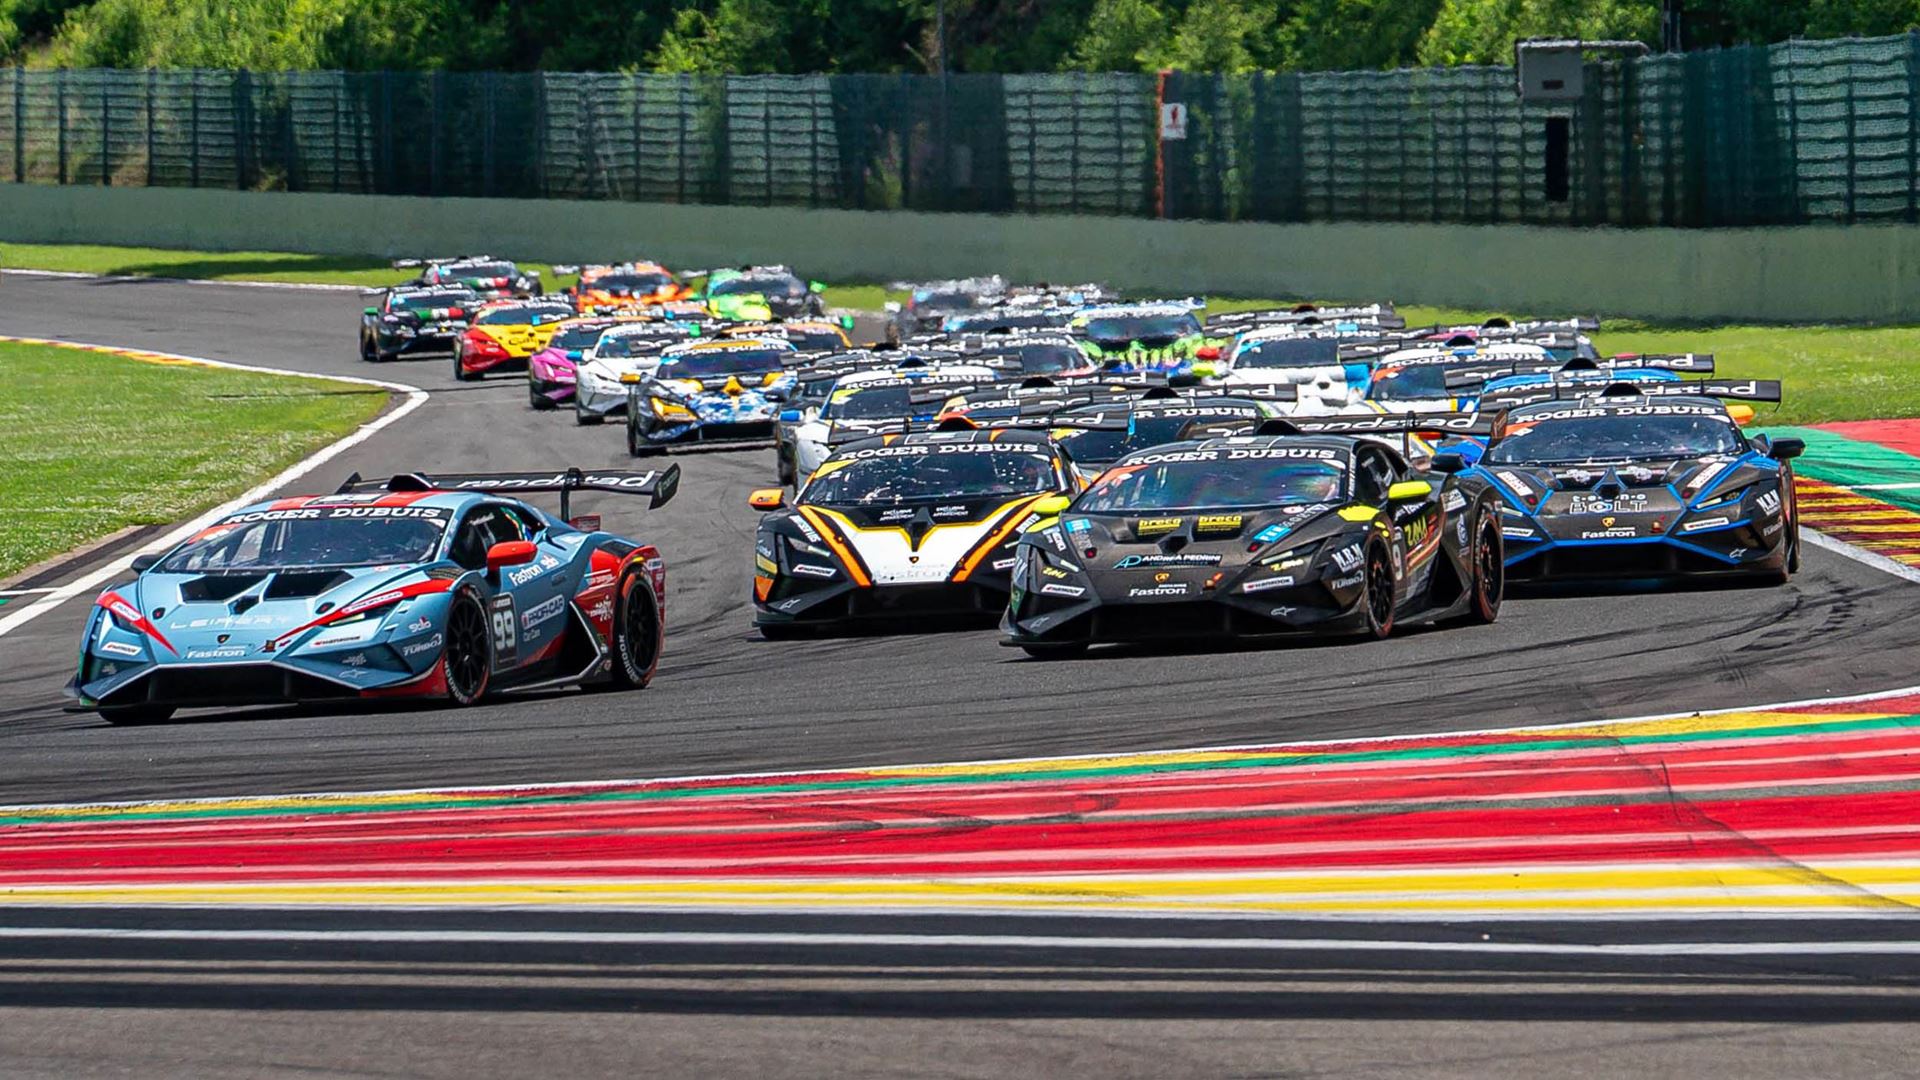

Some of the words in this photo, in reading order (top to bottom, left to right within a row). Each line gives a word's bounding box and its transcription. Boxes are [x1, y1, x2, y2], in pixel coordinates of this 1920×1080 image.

[1515, 408, 1607, 423] ROGER
[1614, 403, 1717, 416] DUBUIS
[840, 446, 928, 460] ROGER
[938, 443, 1039, 454] DUBUIS
[1123, 451, 1218, 466] ROGER
[1228, 448, 1336, 460] DUBUIS
[222, 509, 320, 524] ROGER
[329, 507, 441, 519] DUBUIS
[1582, 530, 1636, 539] Fastron
[508, 563, 543, 587] Fastron
[1129, 588, 1187, 597] Fastron
[493, 610, 516, 649] 99
[186, 649, 246, 659] Fastron
